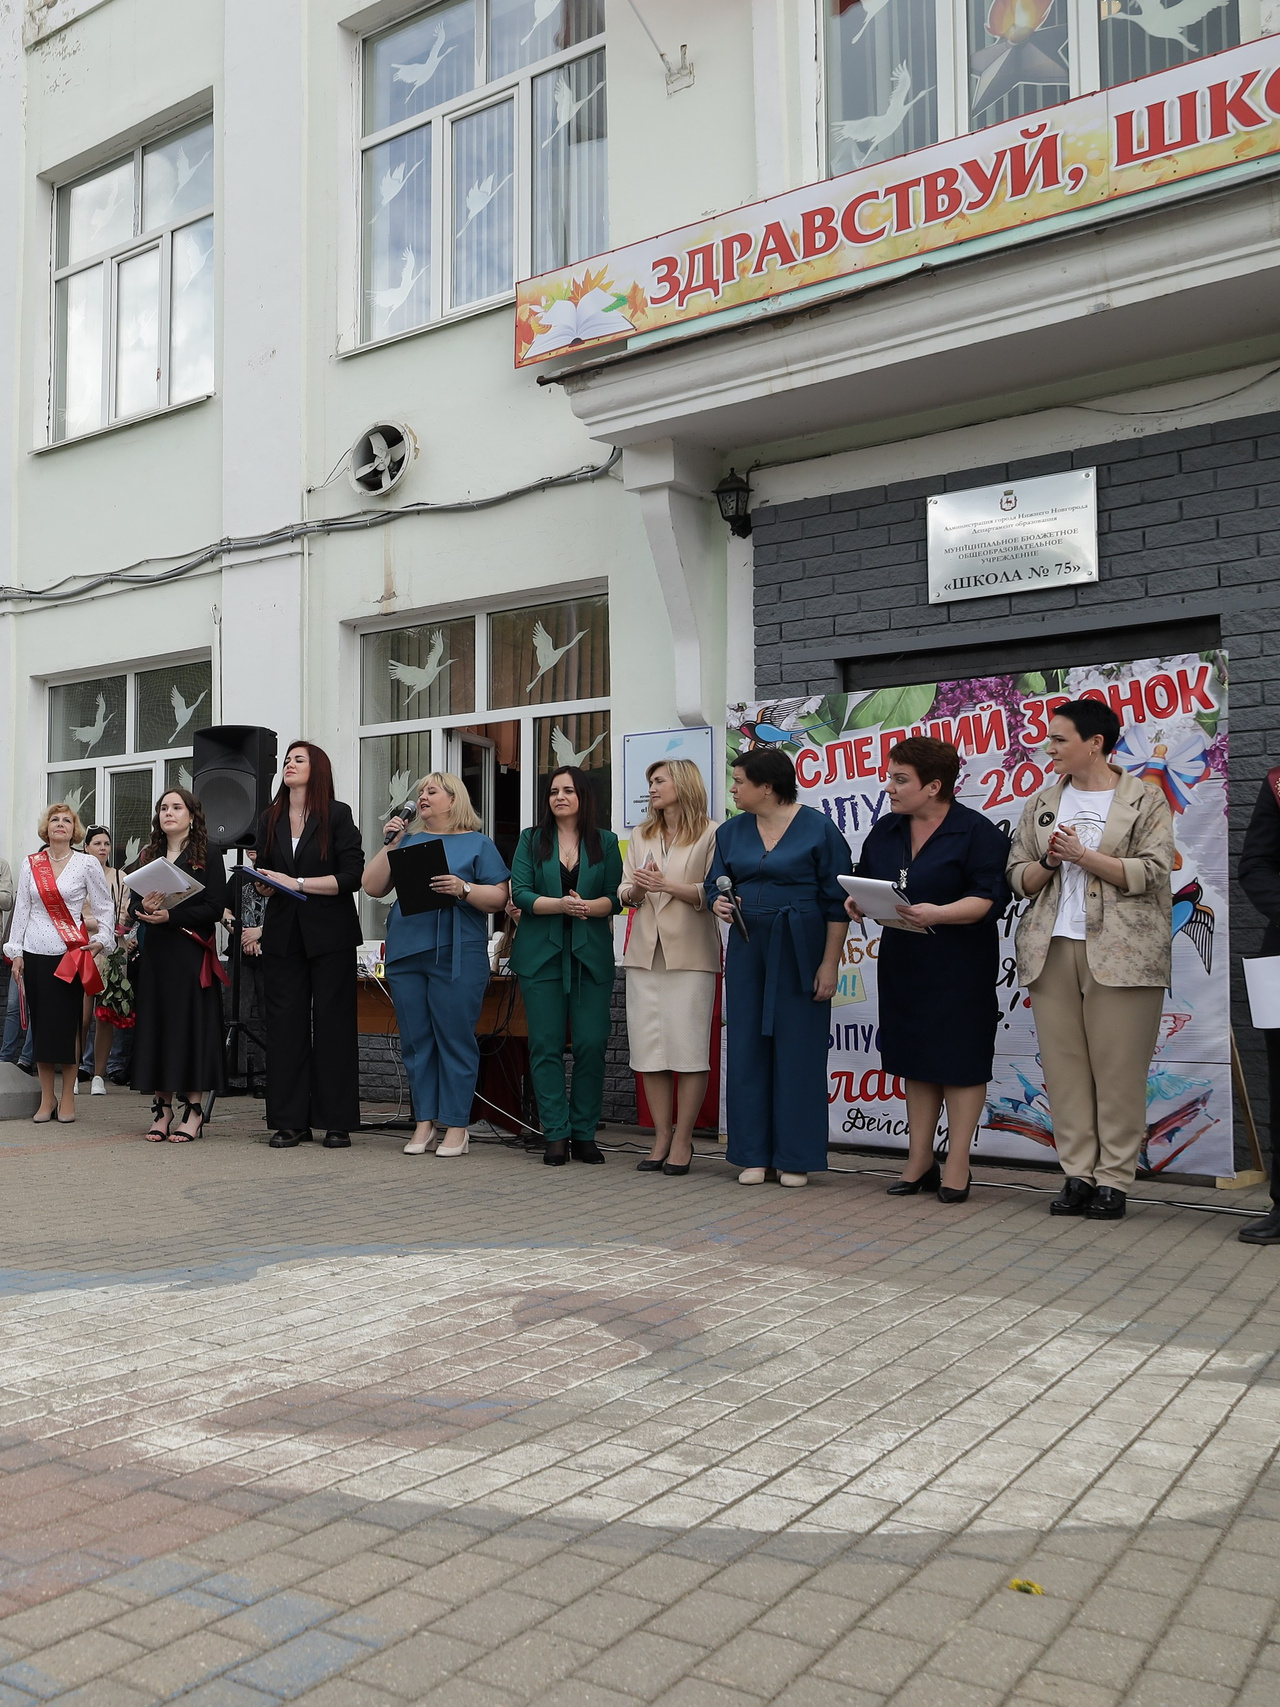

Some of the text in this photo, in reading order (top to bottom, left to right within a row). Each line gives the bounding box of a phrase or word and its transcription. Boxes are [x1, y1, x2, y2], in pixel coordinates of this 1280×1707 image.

[649, 122, 1084, 307] ЗДРАВСТВУЙ,
[944, 504, 1088, 532] Администрация города Нижнего Новгорода
[971, 516, 1057, 535] Департамент образования
[944, 528, 1079, 554] МУНИЦИПАЛЬНОЕ БЮДЖЕТНОЕ
[958, 538, 1063, 560] ОБЩЕОБРАЗОВАТЕЛЬНОЕ
[981, 550, 1039, 564] УЧРЕЖДЕНИЕ
[944, 561, 1081, 591] «ШКОЛА № 75»
[1022, 666, 1215, 745] ЗНОК
